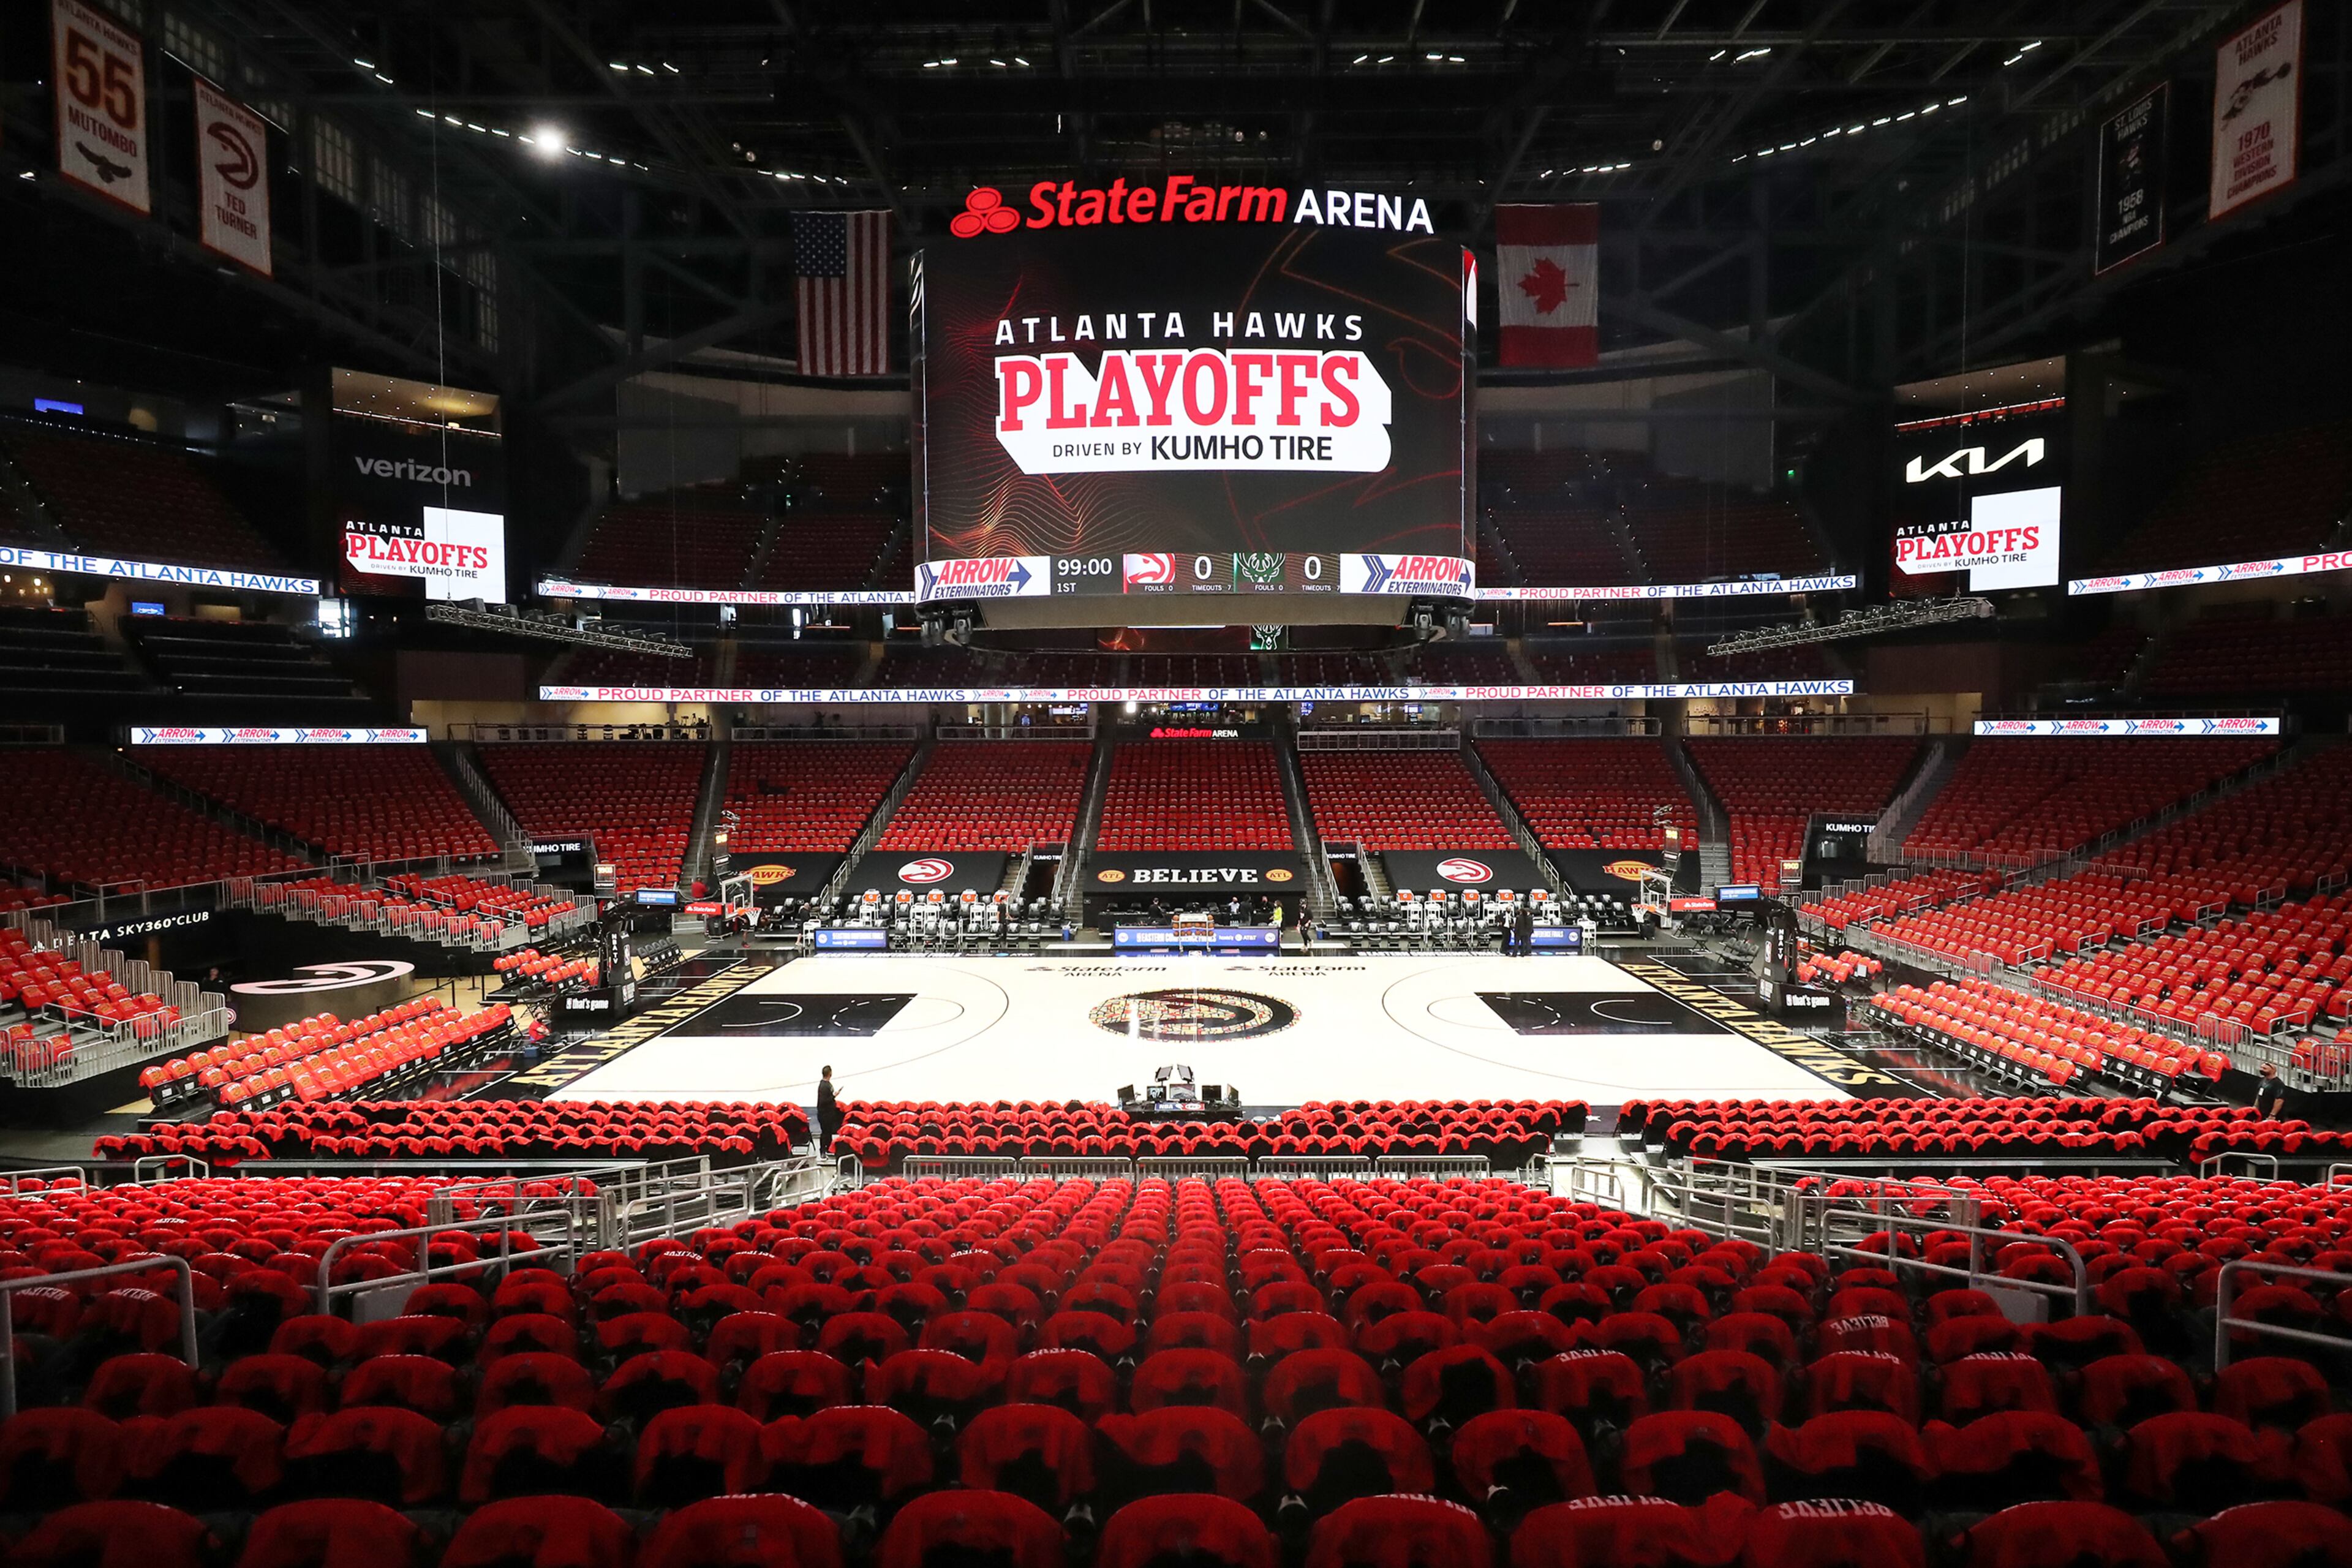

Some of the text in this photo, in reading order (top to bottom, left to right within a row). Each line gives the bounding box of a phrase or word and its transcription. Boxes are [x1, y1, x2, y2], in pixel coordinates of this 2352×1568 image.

[104, 22, 137, 55] HAWKS
[2236, 14, 2282, 54] ATLANTA
[2239, 32, 2277, 66] HAWKS
[67, 27, 137, 130] 55
[2128, 97, 2152, 121] LOUIS
[68, 105, 137, 157] MUTOMBO
[2117, 113, 2148, 141] HAWKS
[2238, 121, 2270, 152] 1970
[2233, 138, 2274, 168] WESTERN
[2234, 154, 2271, 182] DIVISION
[2227, 165, 2277, 200] CHAMPIONS
[225, 191, 246, 216] TED
[1294, 188, 1434, 234] ARENA
[2118, 188, 2144, 214] 1958
[215, 205, 257, 240] TURNER
[2109, 215, 2149, 244] CHAMPIONS
[995, 312, 1363, 345] ATLANTA HAWKS
[1000, 353, 1360, 431] PLAYOFFS
[1054, 435, 1333, 461] DRIVEN BY KUMHO TIRE
[355, 456, 471, 486] verizon
[346, 521, 422, 537] ATLANTA
[1898, 521, 1970, 537] ATLANTA
[349, 535, 488, 568] PLAYOFFS
[1899, 526, 2039, 562] PLAYOFFS
[1058, 558, 1112, 576] 99:00
[1194, 556, 1213, 580] 0
[1304, 556, 1322, 581] 0
[1392, 556, 1464, 582] ARROW
[1955, 556, 1998, 567] KUMHO
[2001, 553, 2027, 562] TIRE
[2235, 562, 2274, 573] ARROW
[2304, 551, 2352, 571] PRO
[0, 548, 315, 593] OF THE ATLANTA HAWKS
[410, 565, 452, 576] KUMHO
[455, 569, 478, 578] TIRE
[937, 559, 1014, 585] ARROW
[2157, 570, 2195, 581] ARROW
[934, 584, 1012, 598] EXTERMINATORS
[1057, 582, 1077, 593] 1ST
[1387, 581, 1462, 595] EXTERMINATORS
[1520, 577, 1853, 598] PROUD PARTNER OF THE ATLANTA HAWKS
[2087, 578, 2122, 588] ARROW
[650, 590, 703, 601] PROUD
[709, 592, 777, 602] PARTNER
[785, 594, 802, 603] OF
[808, 594, 834, 602] THE
[841, 593, 903, 602] ATLANTA
[598, 688, 965, 701] PROUD PARTNER OF THE ATLANTA HAWKS
[1067, 688, 1409, 700] PROUD PARTNER OF THE ATLANTA HAWKS
[1466, 681, 1849, 698] PROUD PARTNER OF THE ATLANTA HAWKS
[157, 729, 197, 737] ARROW
[236, 729, 271, 737] ARROW
[309, 729, 344, 737] ARROW
[2065, 721, 2100, 729] ARROW
[2139, 720, 2176, 729] ARROW
[2217, 719, 2258, 728] ARROW
[1826, 823, 1862, 832] KUMHO
[560, 843, 581, 851] TIRE
[1133, 868, 1258, 883] BELIEVE
[1603, 865, 1657, 874] HAW
[613, 952, 618, 964] TV
[1777, 948, 1784, 959] TV
[573, 998, 609, 1011] that's game
[1792, 995, 1830, 1008] that's game
[508, 966, 774, 1087] ATLANTA HAWKS
[1618, 963, 1900, 1085] ATLANTA HAWKS
[1831, 1315, 1889, 1335] BELIEVE
[1779, 1499, 1894, 1519] BELIEVE
